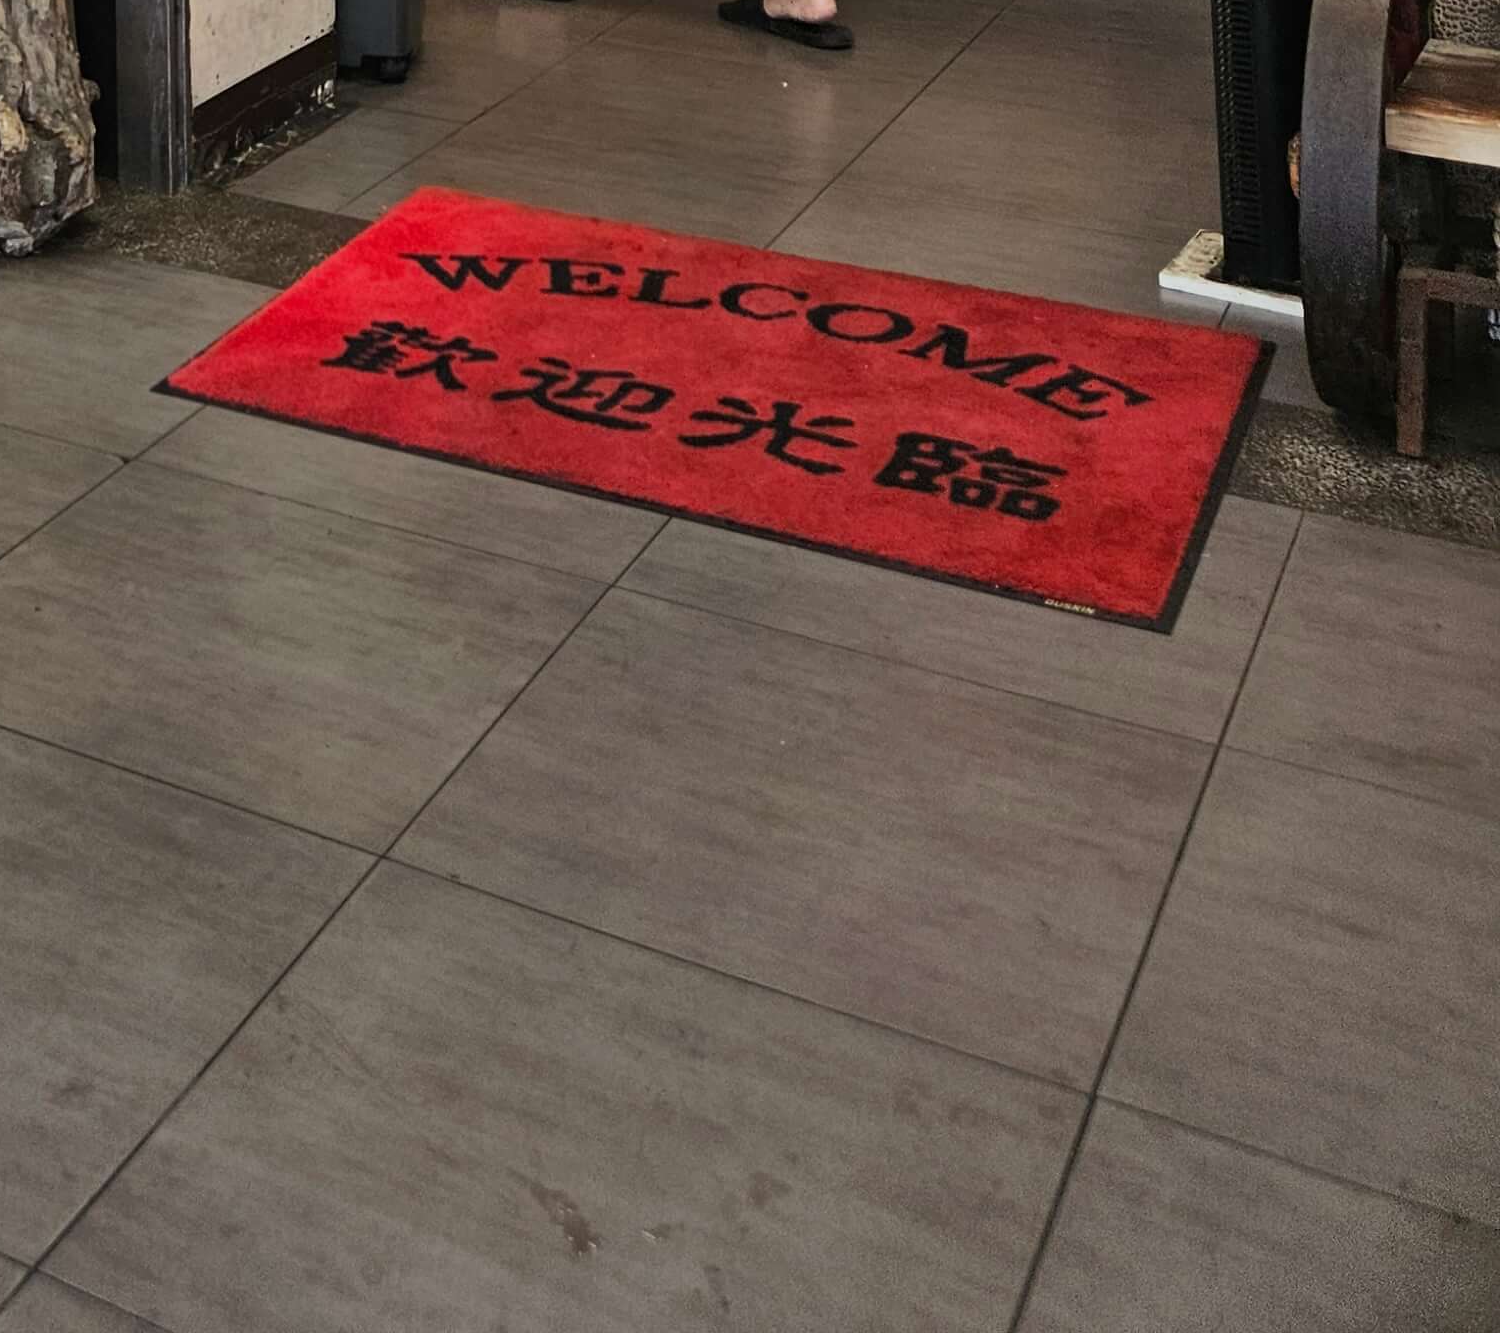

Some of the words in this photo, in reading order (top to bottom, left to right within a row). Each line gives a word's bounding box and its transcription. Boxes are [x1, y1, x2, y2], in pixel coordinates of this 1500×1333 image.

[319, 319, 1068, 523] 歡迎光臨
[398, 251, 1155, 425] WELCOME
